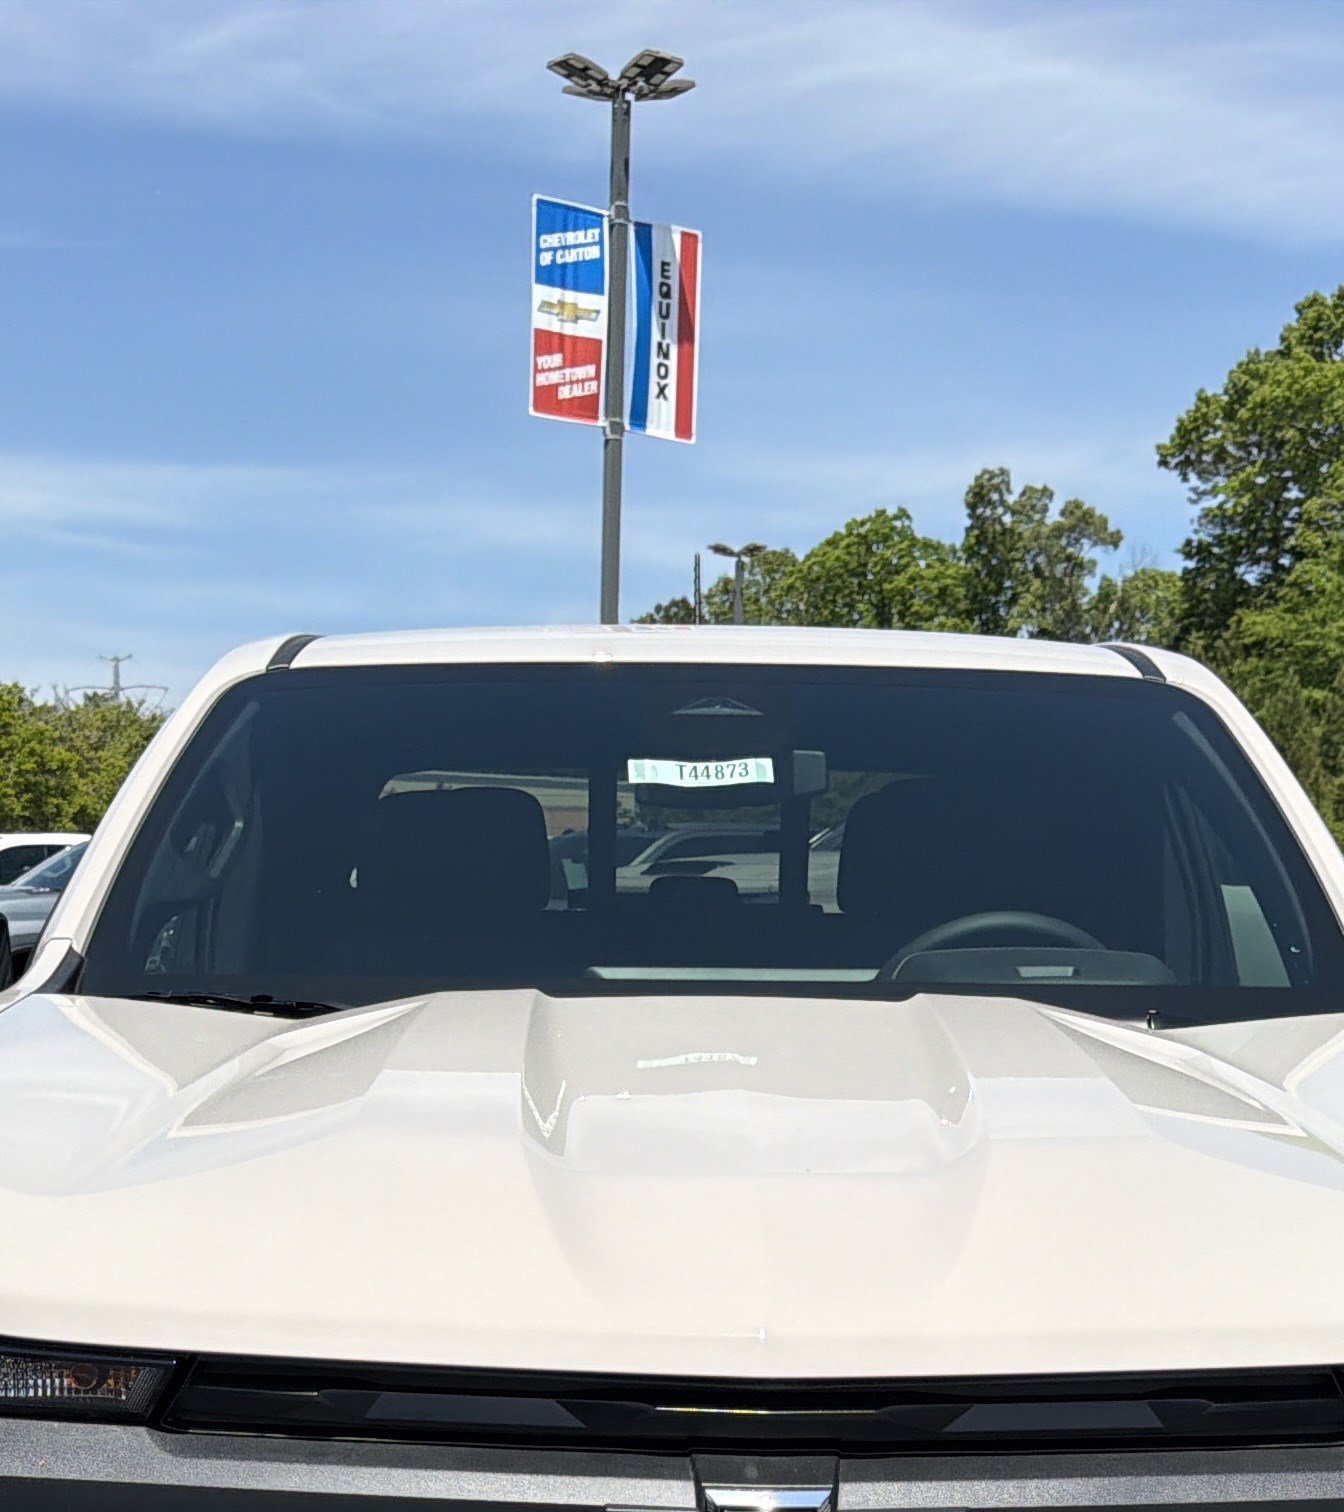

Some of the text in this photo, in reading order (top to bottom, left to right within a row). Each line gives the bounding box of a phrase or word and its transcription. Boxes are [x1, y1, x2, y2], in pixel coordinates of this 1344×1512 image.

[539, 227, 601, 249] CHEVROLET
[539, 251, 555, 267] OF
[655, 260, 672, 401] EQUINOX
[536, 353, 564, 370] YOUR
[557, 380, 599, 400] DEALER
[675, 762, 749, 781] T44873
